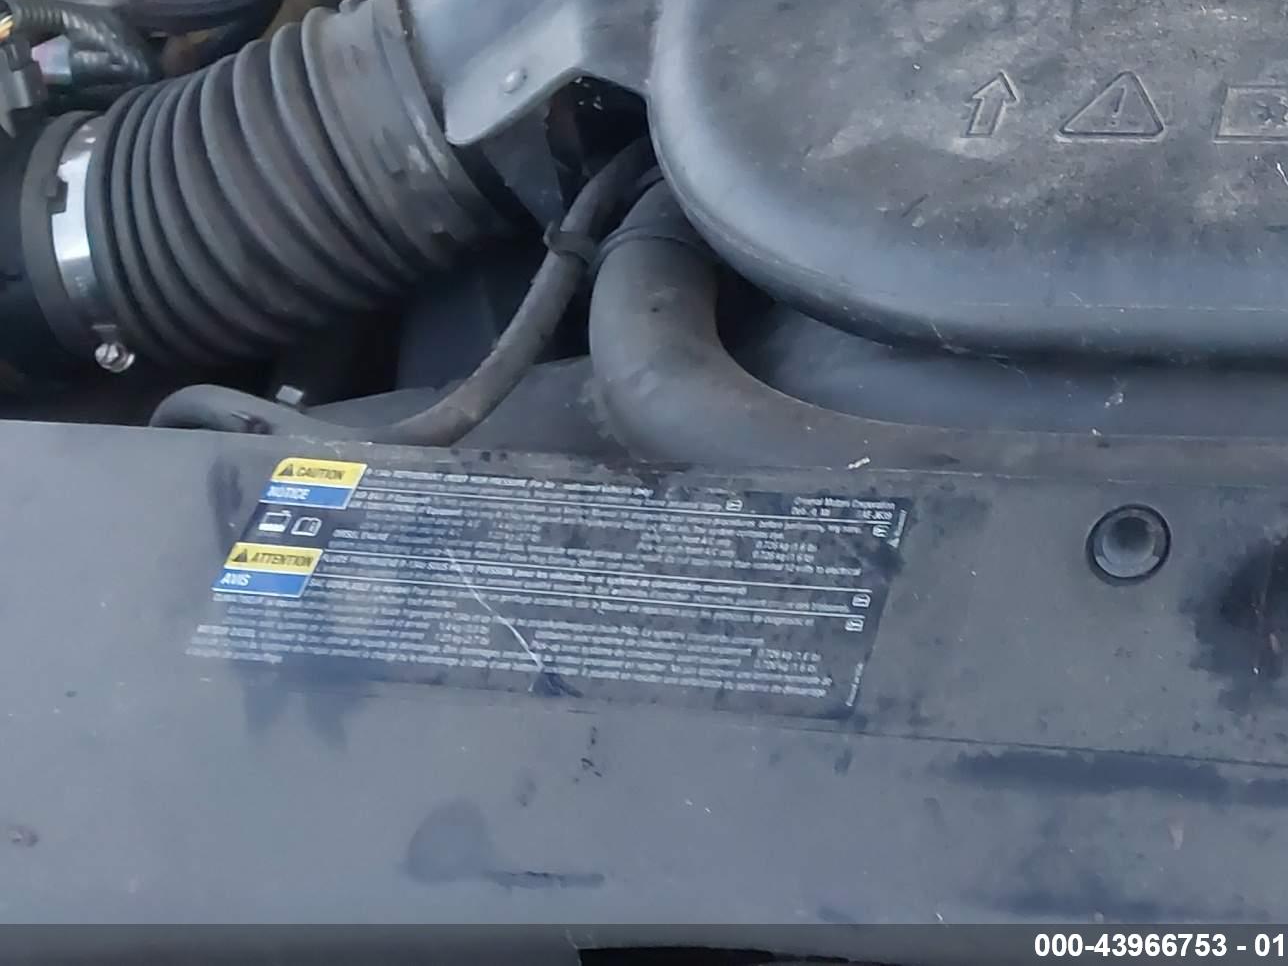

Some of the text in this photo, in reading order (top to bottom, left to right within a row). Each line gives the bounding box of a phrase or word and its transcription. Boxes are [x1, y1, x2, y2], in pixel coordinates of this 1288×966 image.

[296, 467, 345, 480] CAUTION
[266, 485, 311, 500] NOTICE
[250, 552, 313, 567] ATTENTION
[220, 572, 252, 586] AVIS
